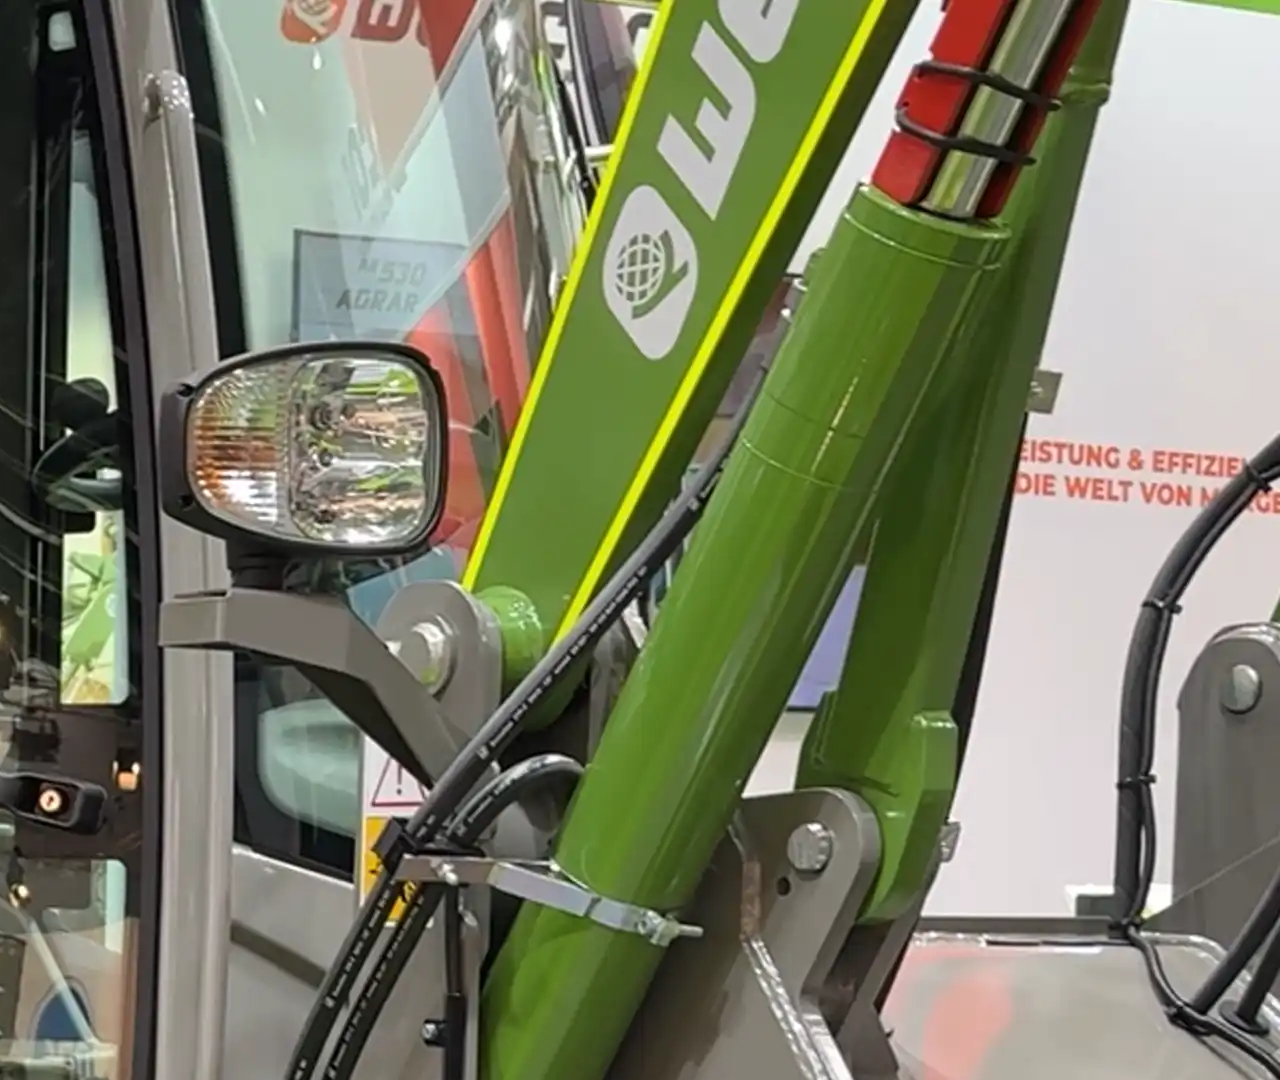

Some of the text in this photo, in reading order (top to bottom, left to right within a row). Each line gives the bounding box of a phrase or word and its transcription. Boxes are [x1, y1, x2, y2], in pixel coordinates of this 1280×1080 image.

[334, 288, 420, 314] AGRAR
[1127, 448, 1145, 471] &
[1152, 450, 1247, 479] EFFIZIE
[1015, 472, 1057, 497] DIE
[1064, 476, 1134, 503] WELT
[1140, 482, 1193, 507] VON
